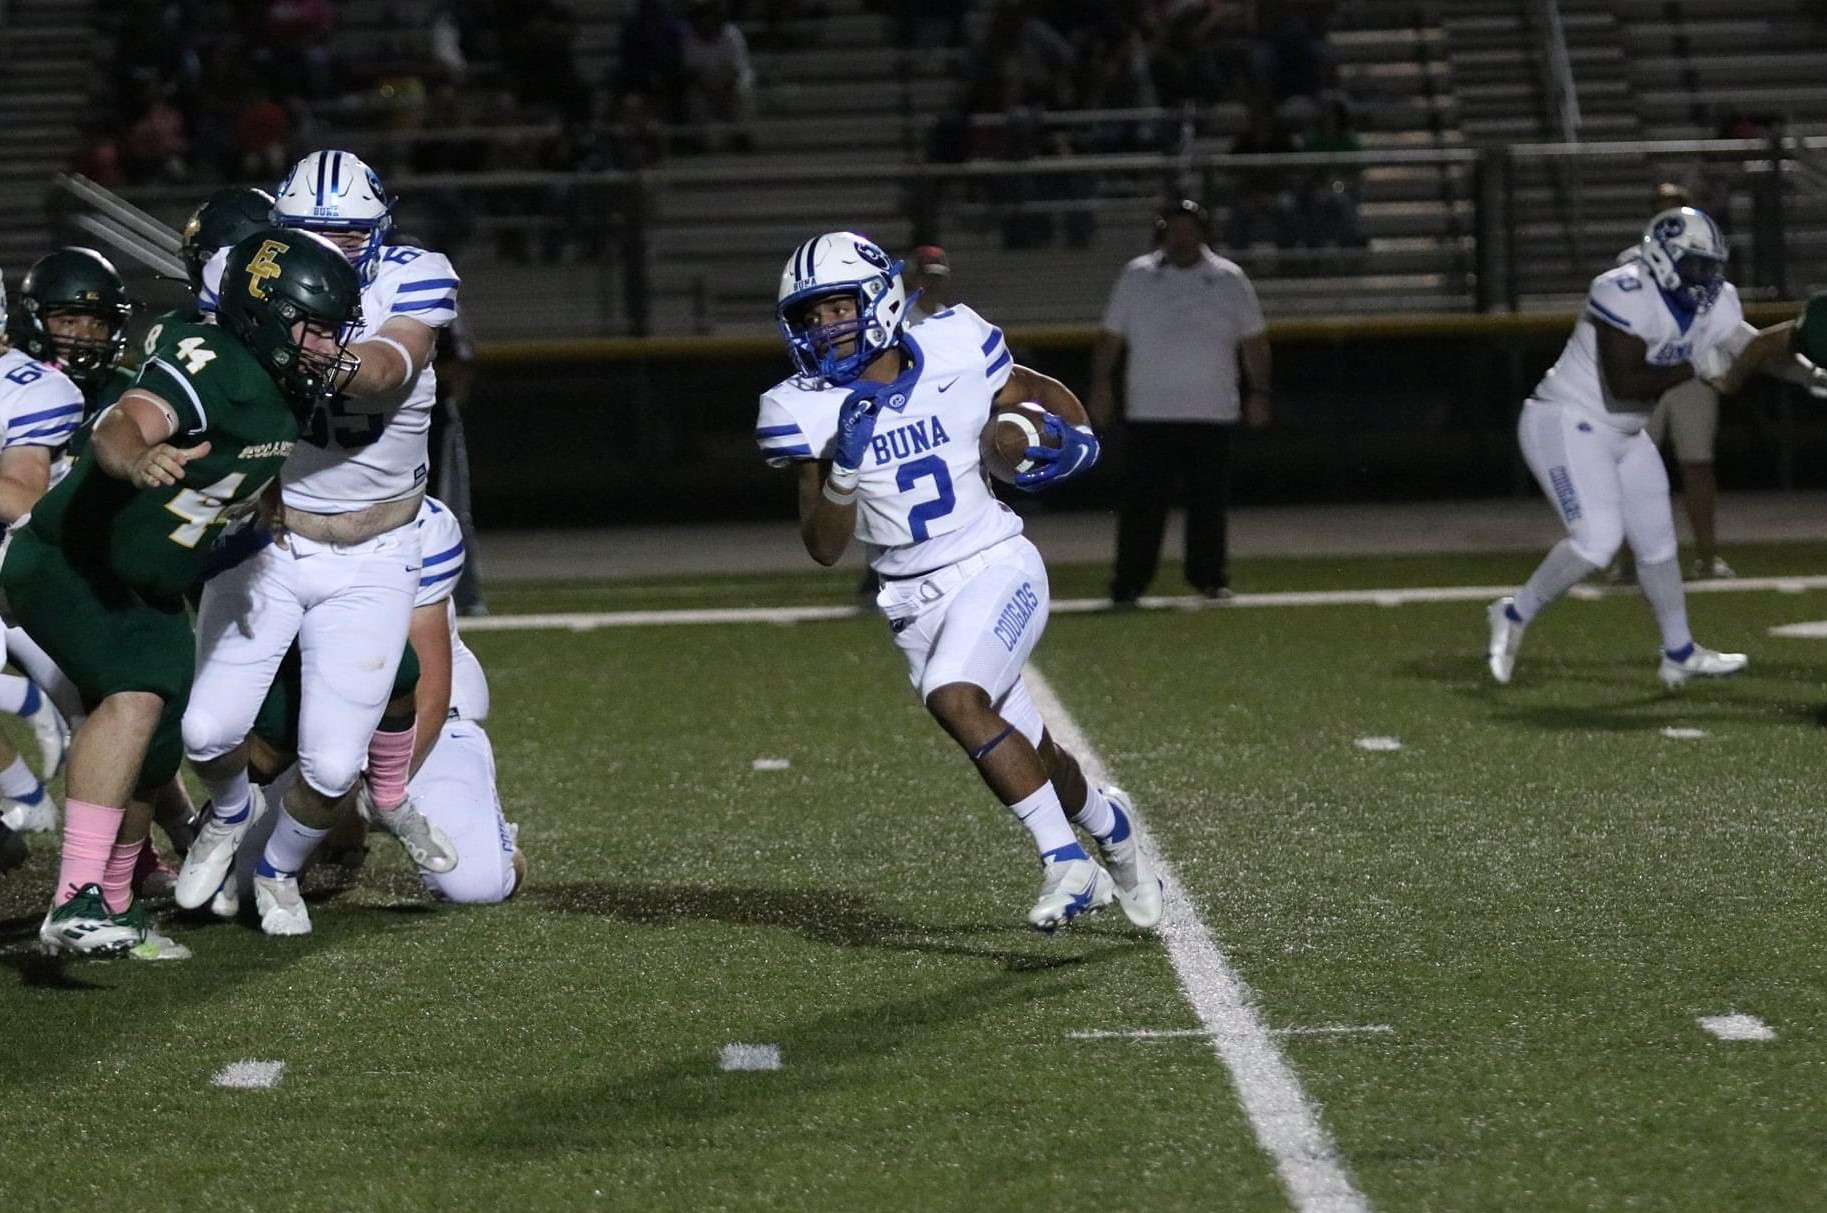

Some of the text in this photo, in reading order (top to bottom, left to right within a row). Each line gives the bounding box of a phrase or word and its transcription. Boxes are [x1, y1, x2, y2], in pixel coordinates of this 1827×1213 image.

[794, 277, 817, 291] BUNA
[175, 336, 217, 375] 44
[872, 415, 950, 466] BUNA
[895, 454, 956, 544] 2
[994, 582, 1038, 652] COUGARS
